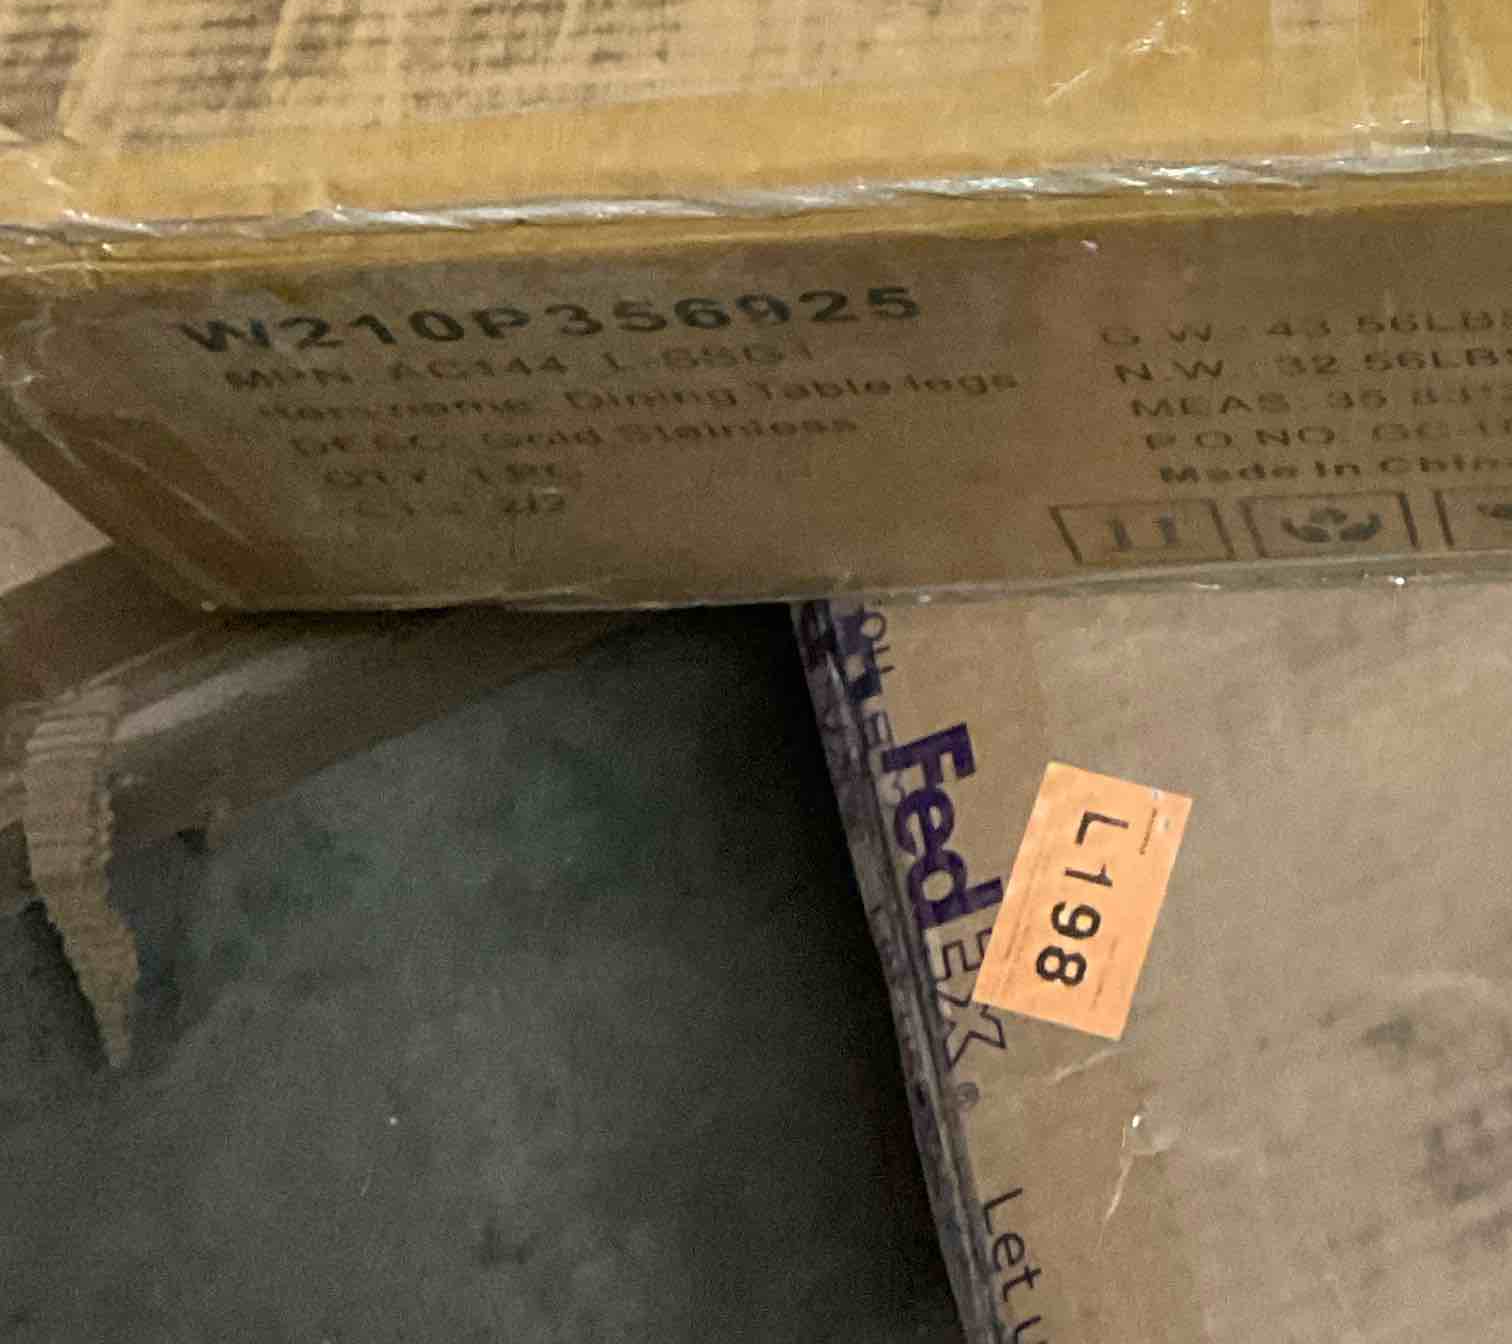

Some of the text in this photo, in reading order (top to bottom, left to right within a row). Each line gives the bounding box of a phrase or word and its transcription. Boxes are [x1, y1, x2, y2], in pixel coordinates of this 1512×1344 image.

[174, 286, 921, 353] W210P356925
[563, 385, 738, 410] Dining
[755, 376, 893, 403] Table
[902, 372, 1018, 398] legs
[612, 417, 858, 444] Stainless
[1159, 462, 1298, 484] Made
[983, 1186, 1043, 1303] Let
